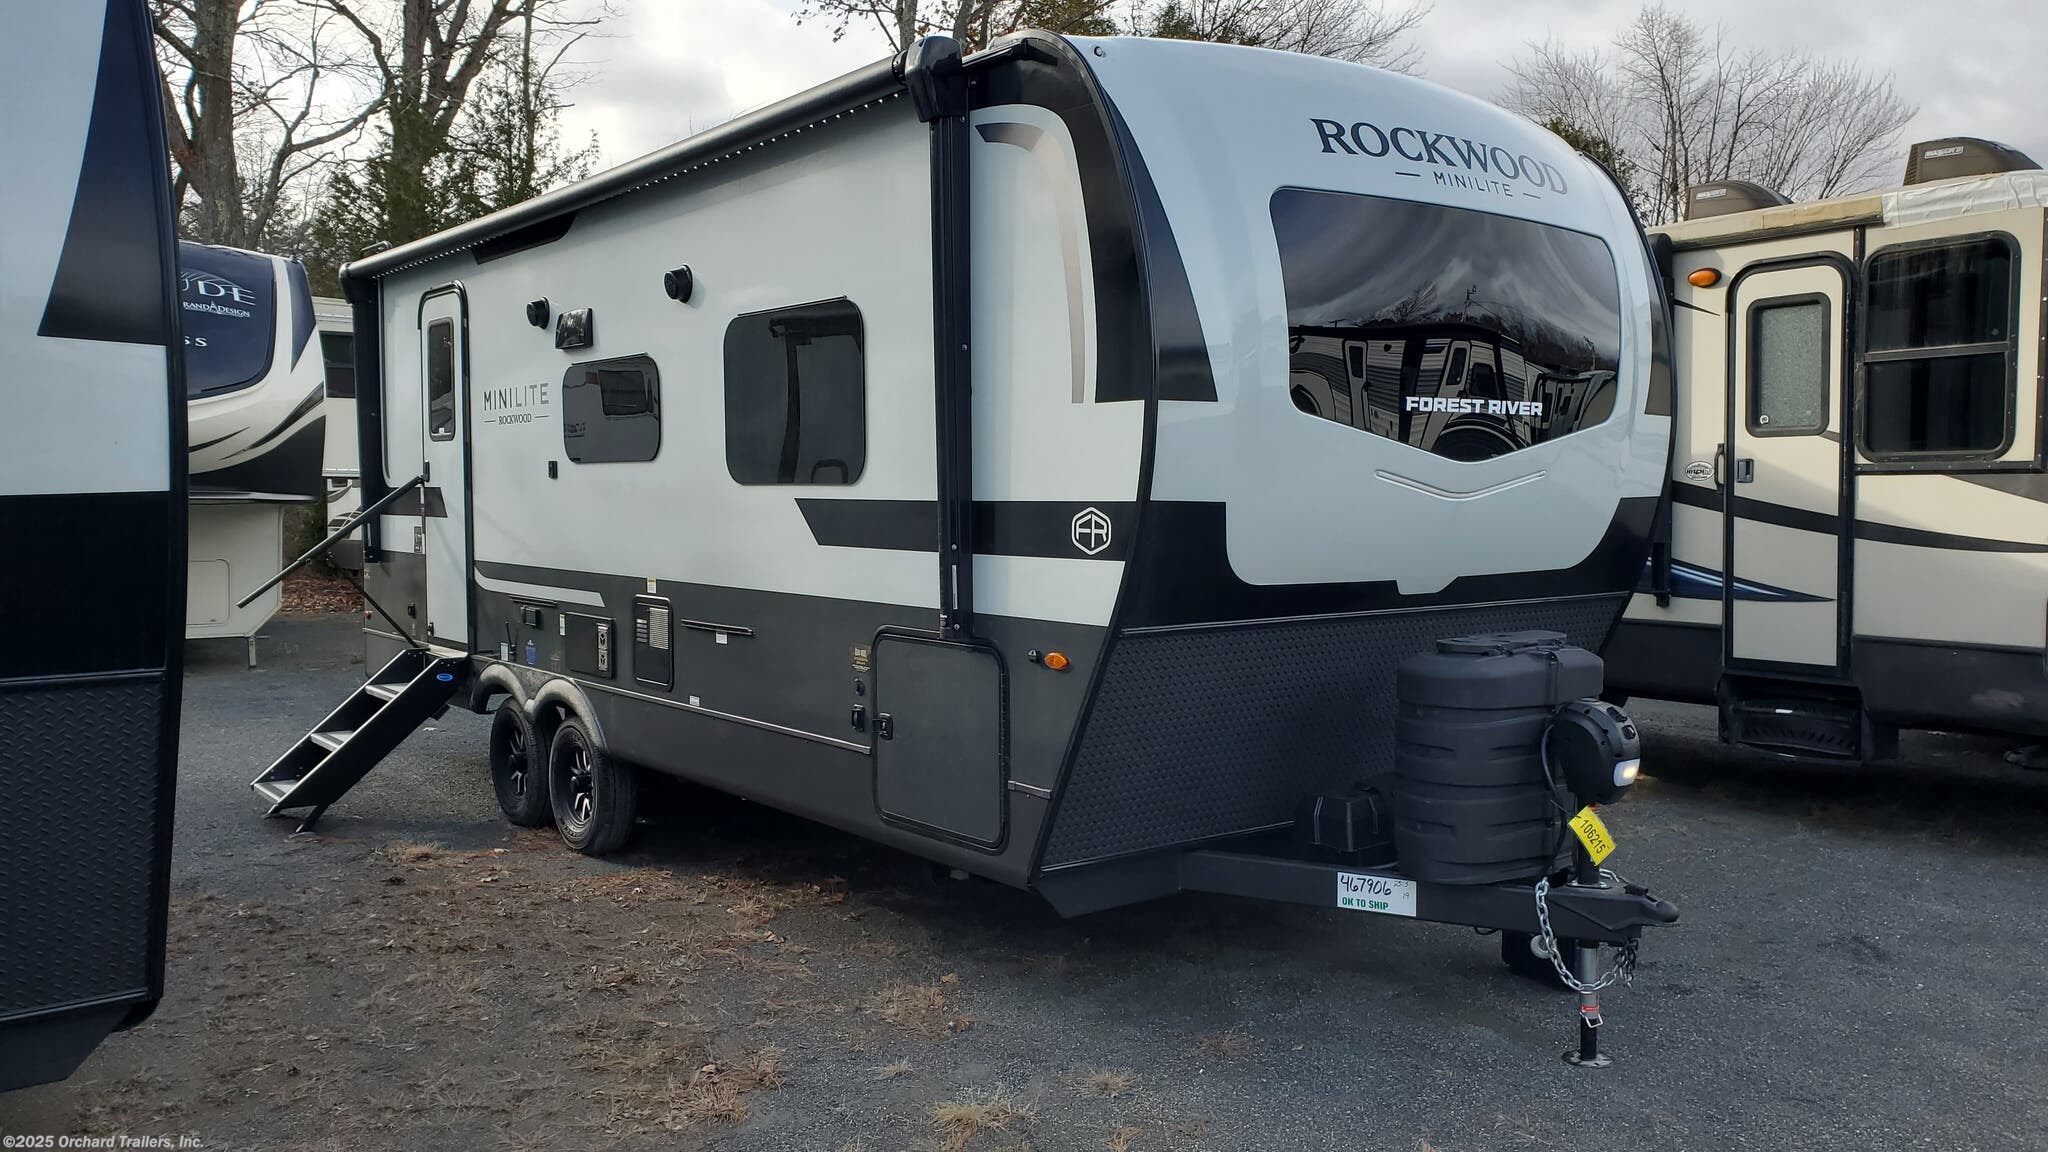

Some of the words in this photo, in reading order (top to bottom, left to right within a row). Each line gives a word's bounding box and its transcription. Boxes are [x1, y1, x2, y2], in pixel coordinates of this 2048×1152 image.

[1310, 118, 1568, 195] ROCKWOOD
[1433, 171, 1513, 197] MINILITE
[484, 382, 549, 411] MINILITE
[1406, 396, 1485, 414] FOREST
[1488, 399, 1543, 416] RIVER
[499, 413, 532, 425] ROCKWOOD
[1580, 819, 1606, 854] 106215
[1340, 874, 1392, 896] 467906
[1342, 897, 1354, 906] OK
[1355, 898, 1366, 907] TO
[1368, 900, 1389, 911] SHIP
